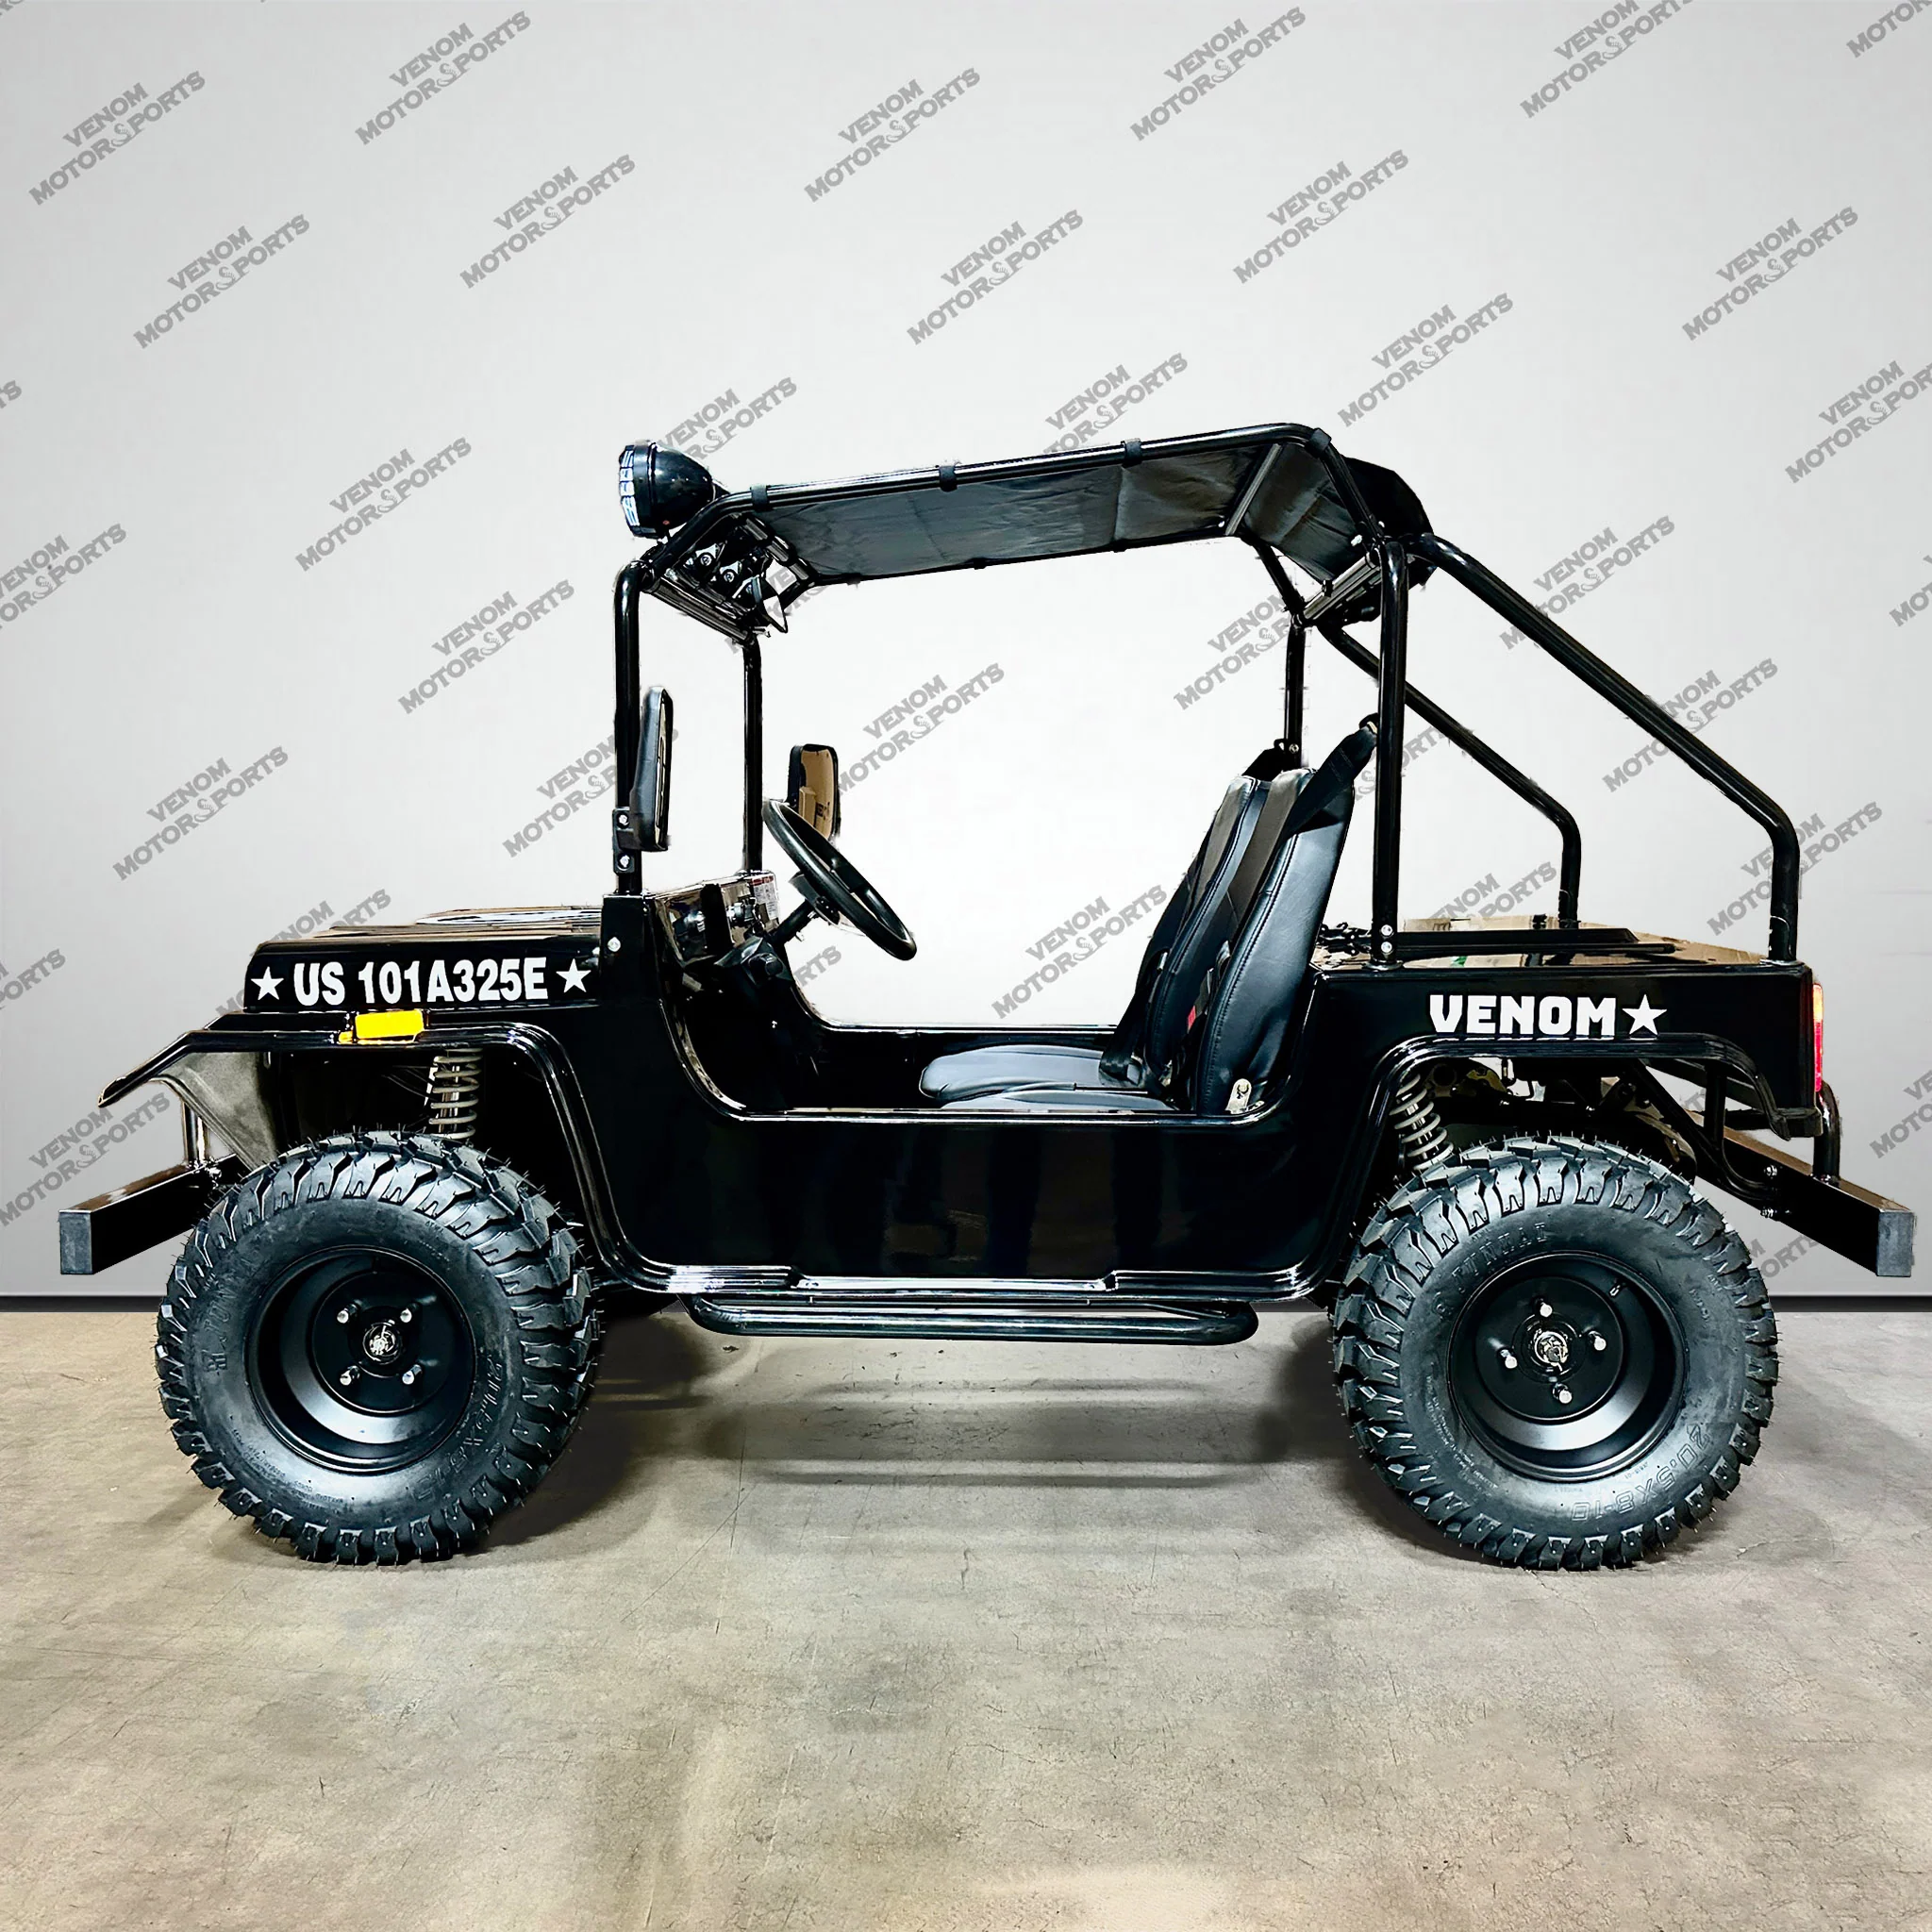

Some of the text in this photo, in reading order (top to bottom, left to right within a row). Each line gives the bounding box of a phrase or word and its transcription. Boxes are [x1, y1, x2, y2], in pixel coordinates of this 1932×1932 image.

[294, 962, 344, 1006] US
[358, 958, 548, 1004] 101A325E
[1430, 995, 1615, 1036] VENOM
